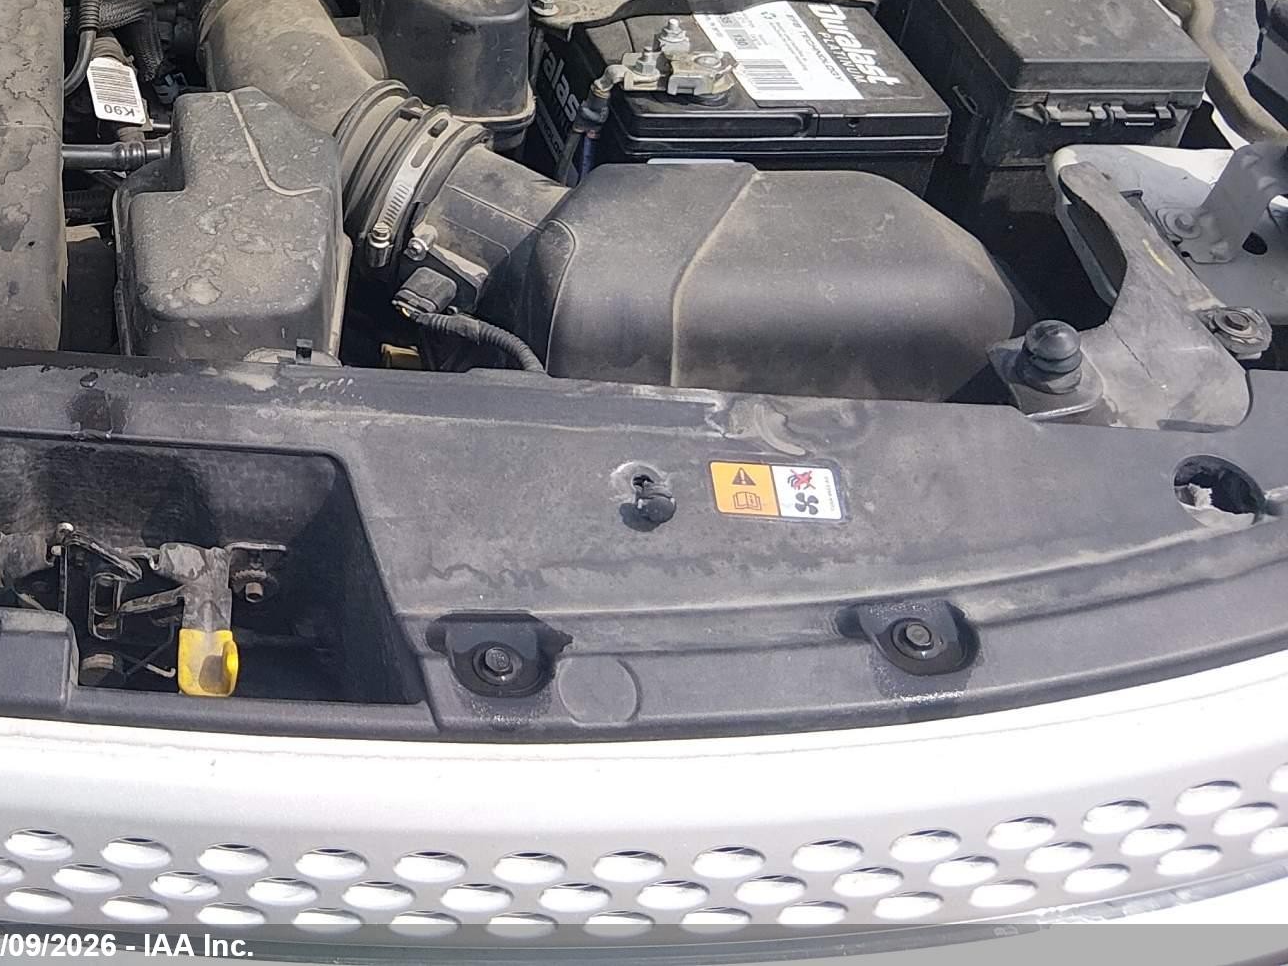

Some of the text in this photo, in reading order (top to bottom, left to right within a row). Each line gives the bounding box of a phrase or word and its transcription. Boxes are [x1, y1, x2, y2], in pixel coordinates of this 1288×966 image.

[800, 26, 847, 83] TECHNOLOGY
[807, 3, 902, 86] Duralast
[817, 31, 868, 84] PLATINUM
[103, 104, 136, 118] K90
